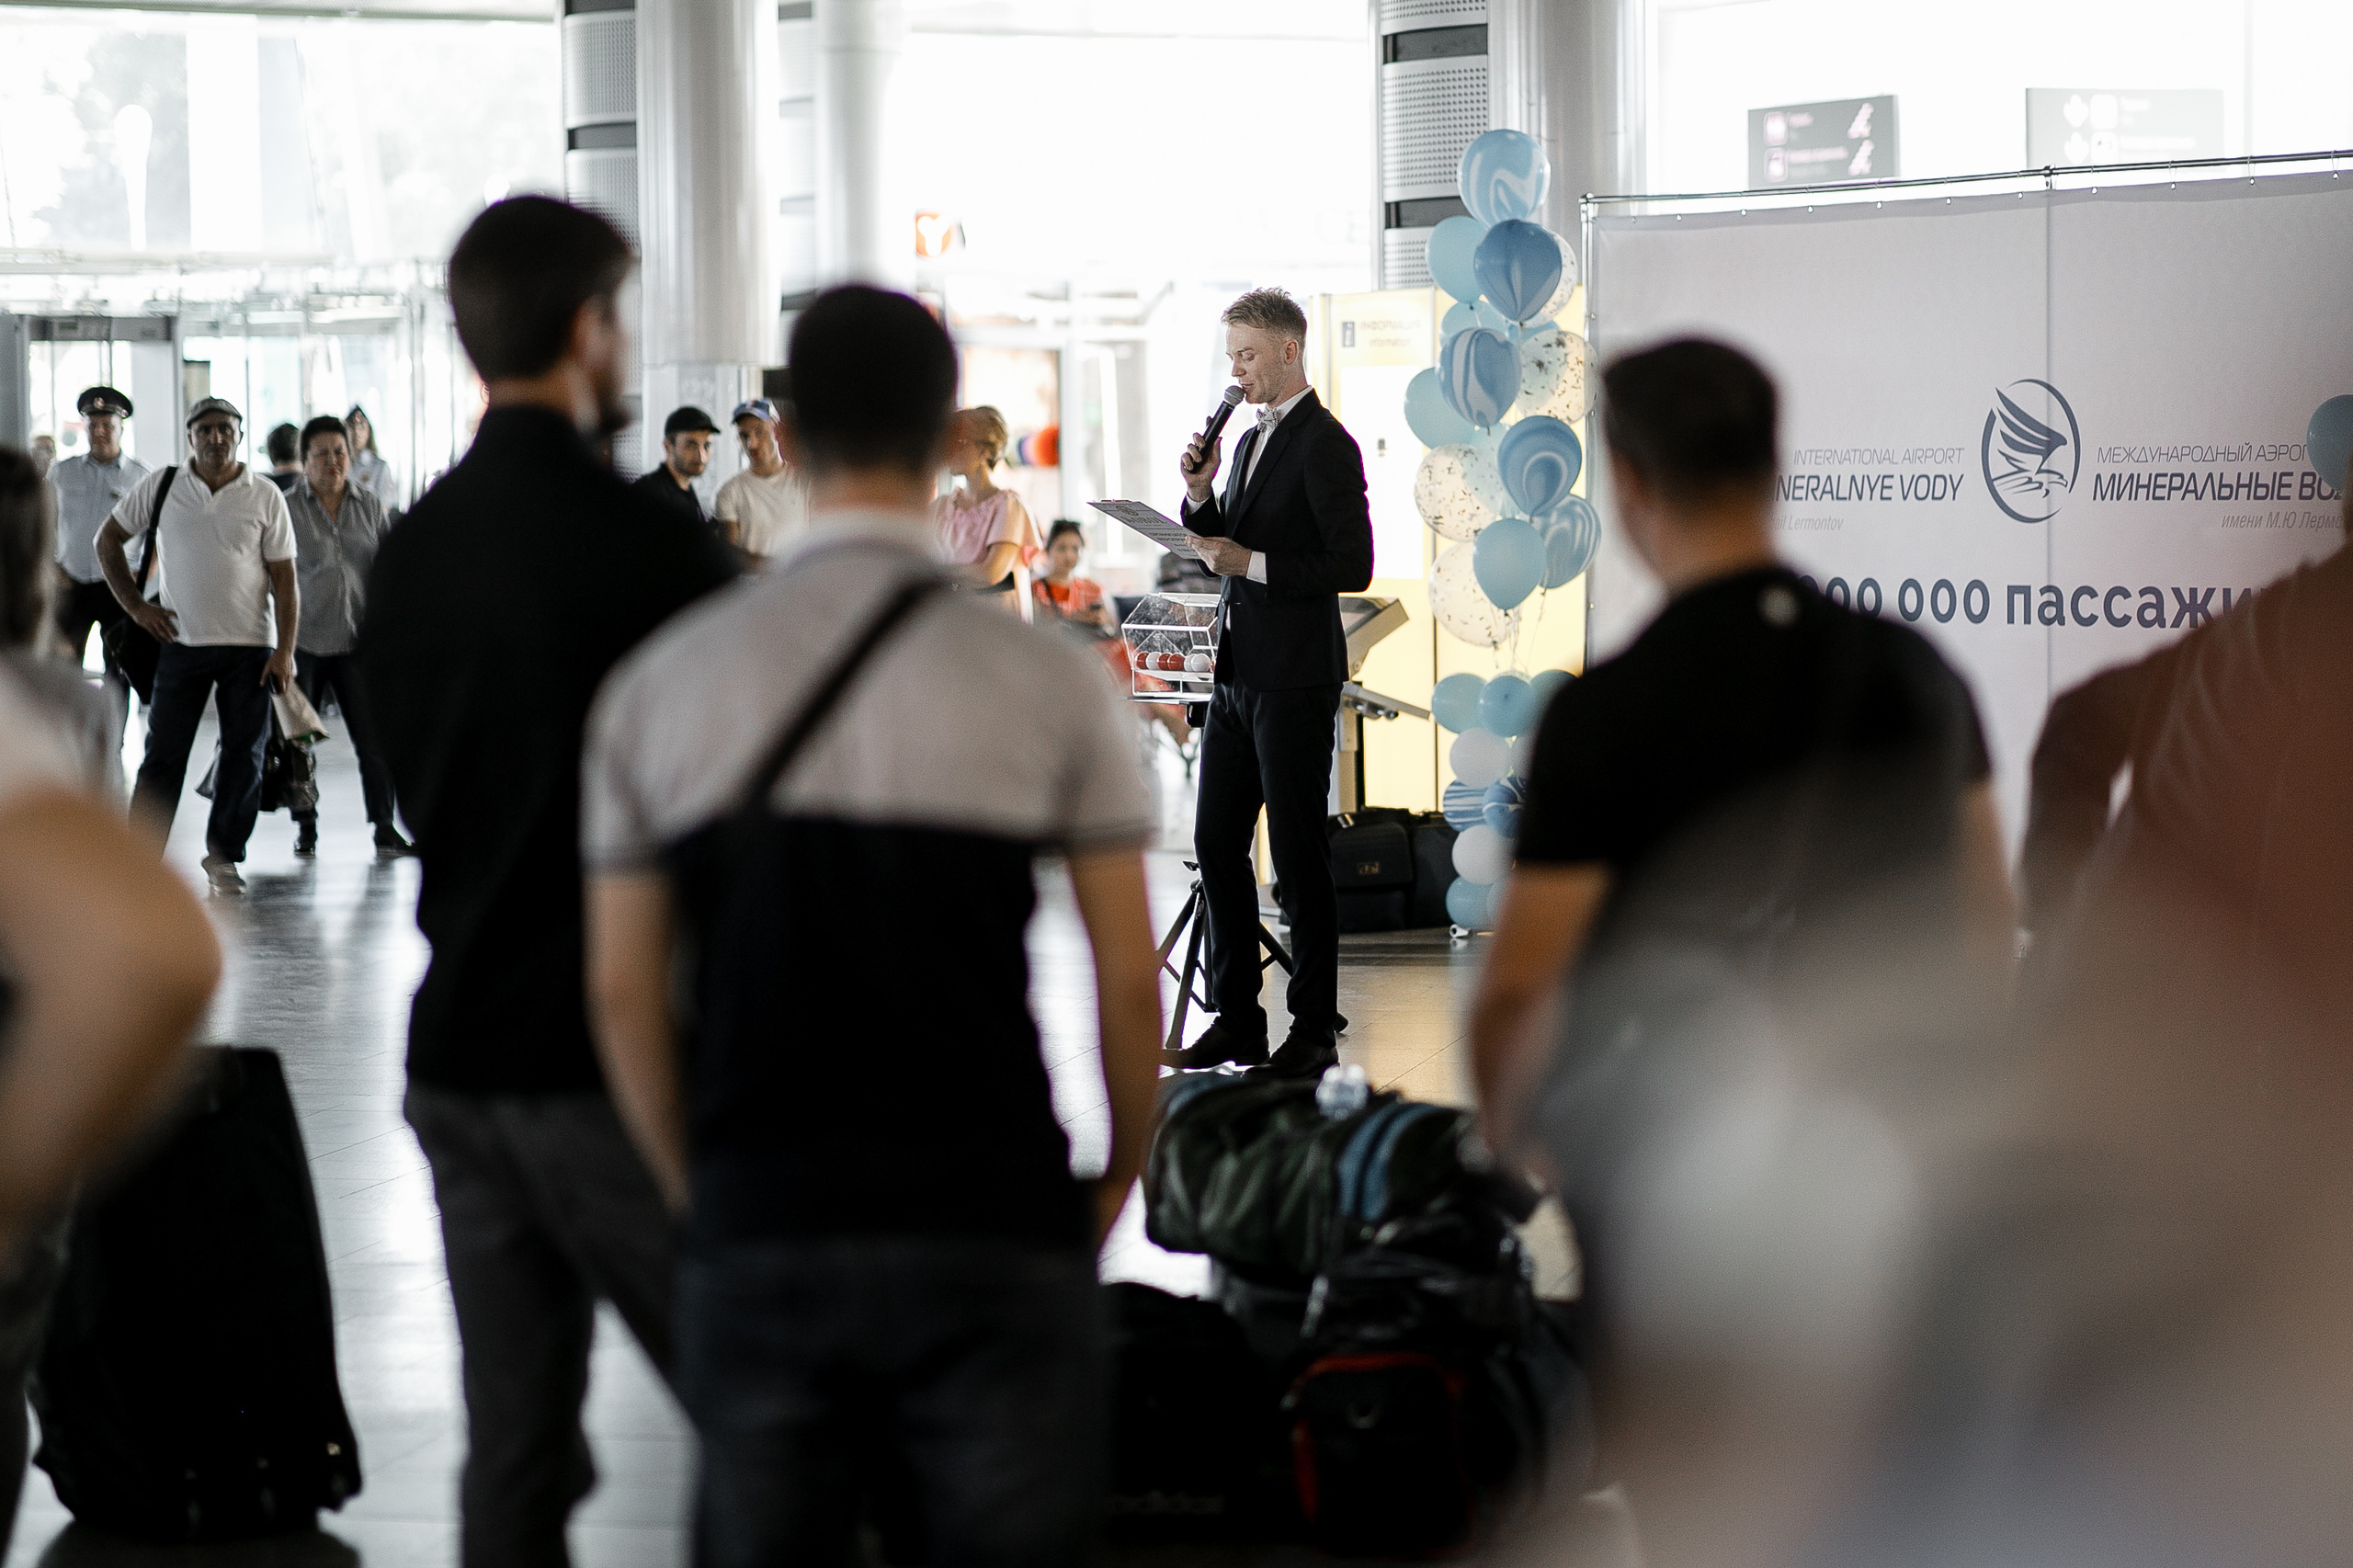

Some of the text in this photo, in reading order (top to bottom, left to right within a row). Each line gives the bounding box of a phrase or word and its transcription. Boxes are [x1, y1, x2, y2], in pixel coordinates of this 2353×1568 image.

[1793, 447, 1965, 466] INTERNATIONAL AIRPORT
[2097, 441, 2253, 463] МЕЖДУНАРОДНЫЙ
[1775, 473, 1965, 502] NERALNYE VODY
[2092, 471, 2294, 501] МИНЕРАЛЬНЫЕ
[1788, 515, 1844, 530] Lermontov
[2221, 515, 2264, 528] имени
[1898, 578, 1991, 625] 000
